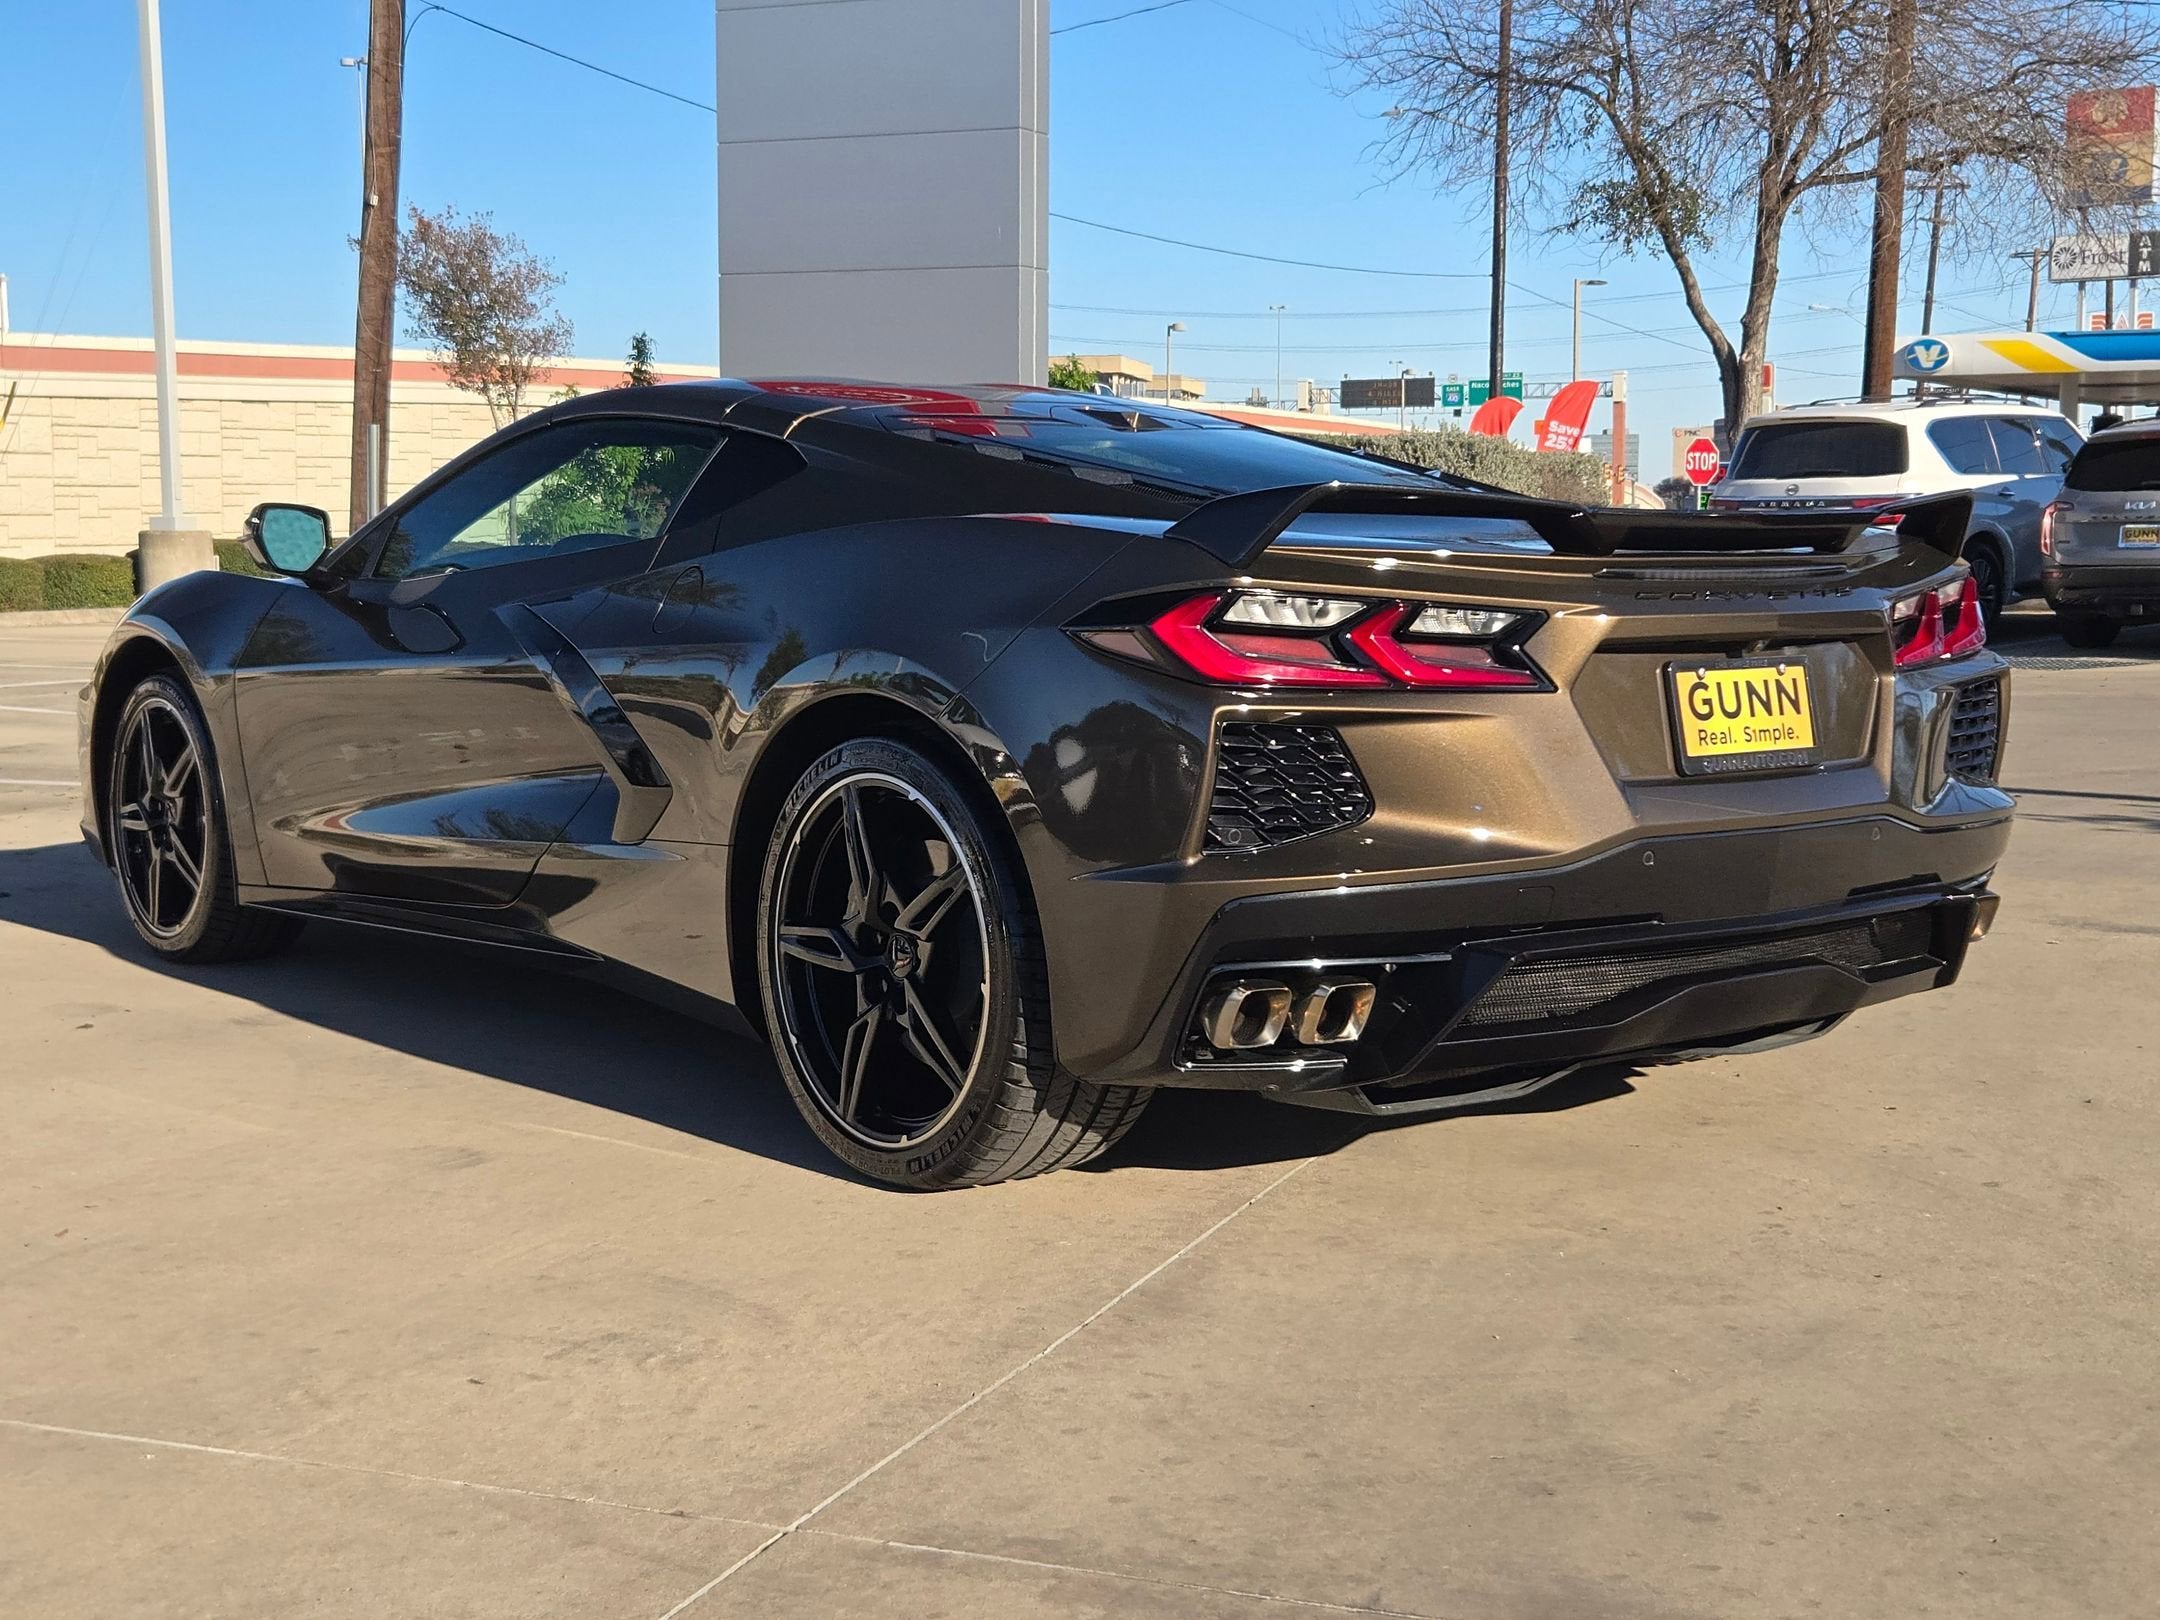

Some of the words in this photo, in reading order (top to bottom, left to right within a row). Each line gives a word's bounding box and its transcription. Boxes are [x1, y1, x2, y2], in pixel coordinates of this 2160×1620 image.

[2081, 249, 2127, 265] Frost
[2137, 234, 2152, 272] ATM
[1549, 420, 1580, 437] Save
[1686, 451, 1717, 471] STOP
[2124, 528, 2160, 538] GUNN
[1688, 677, 1802, 721] GUNN
[1698, 726, 1738, 747] Real.
[1743, 723, 1800, 744] Simple.
